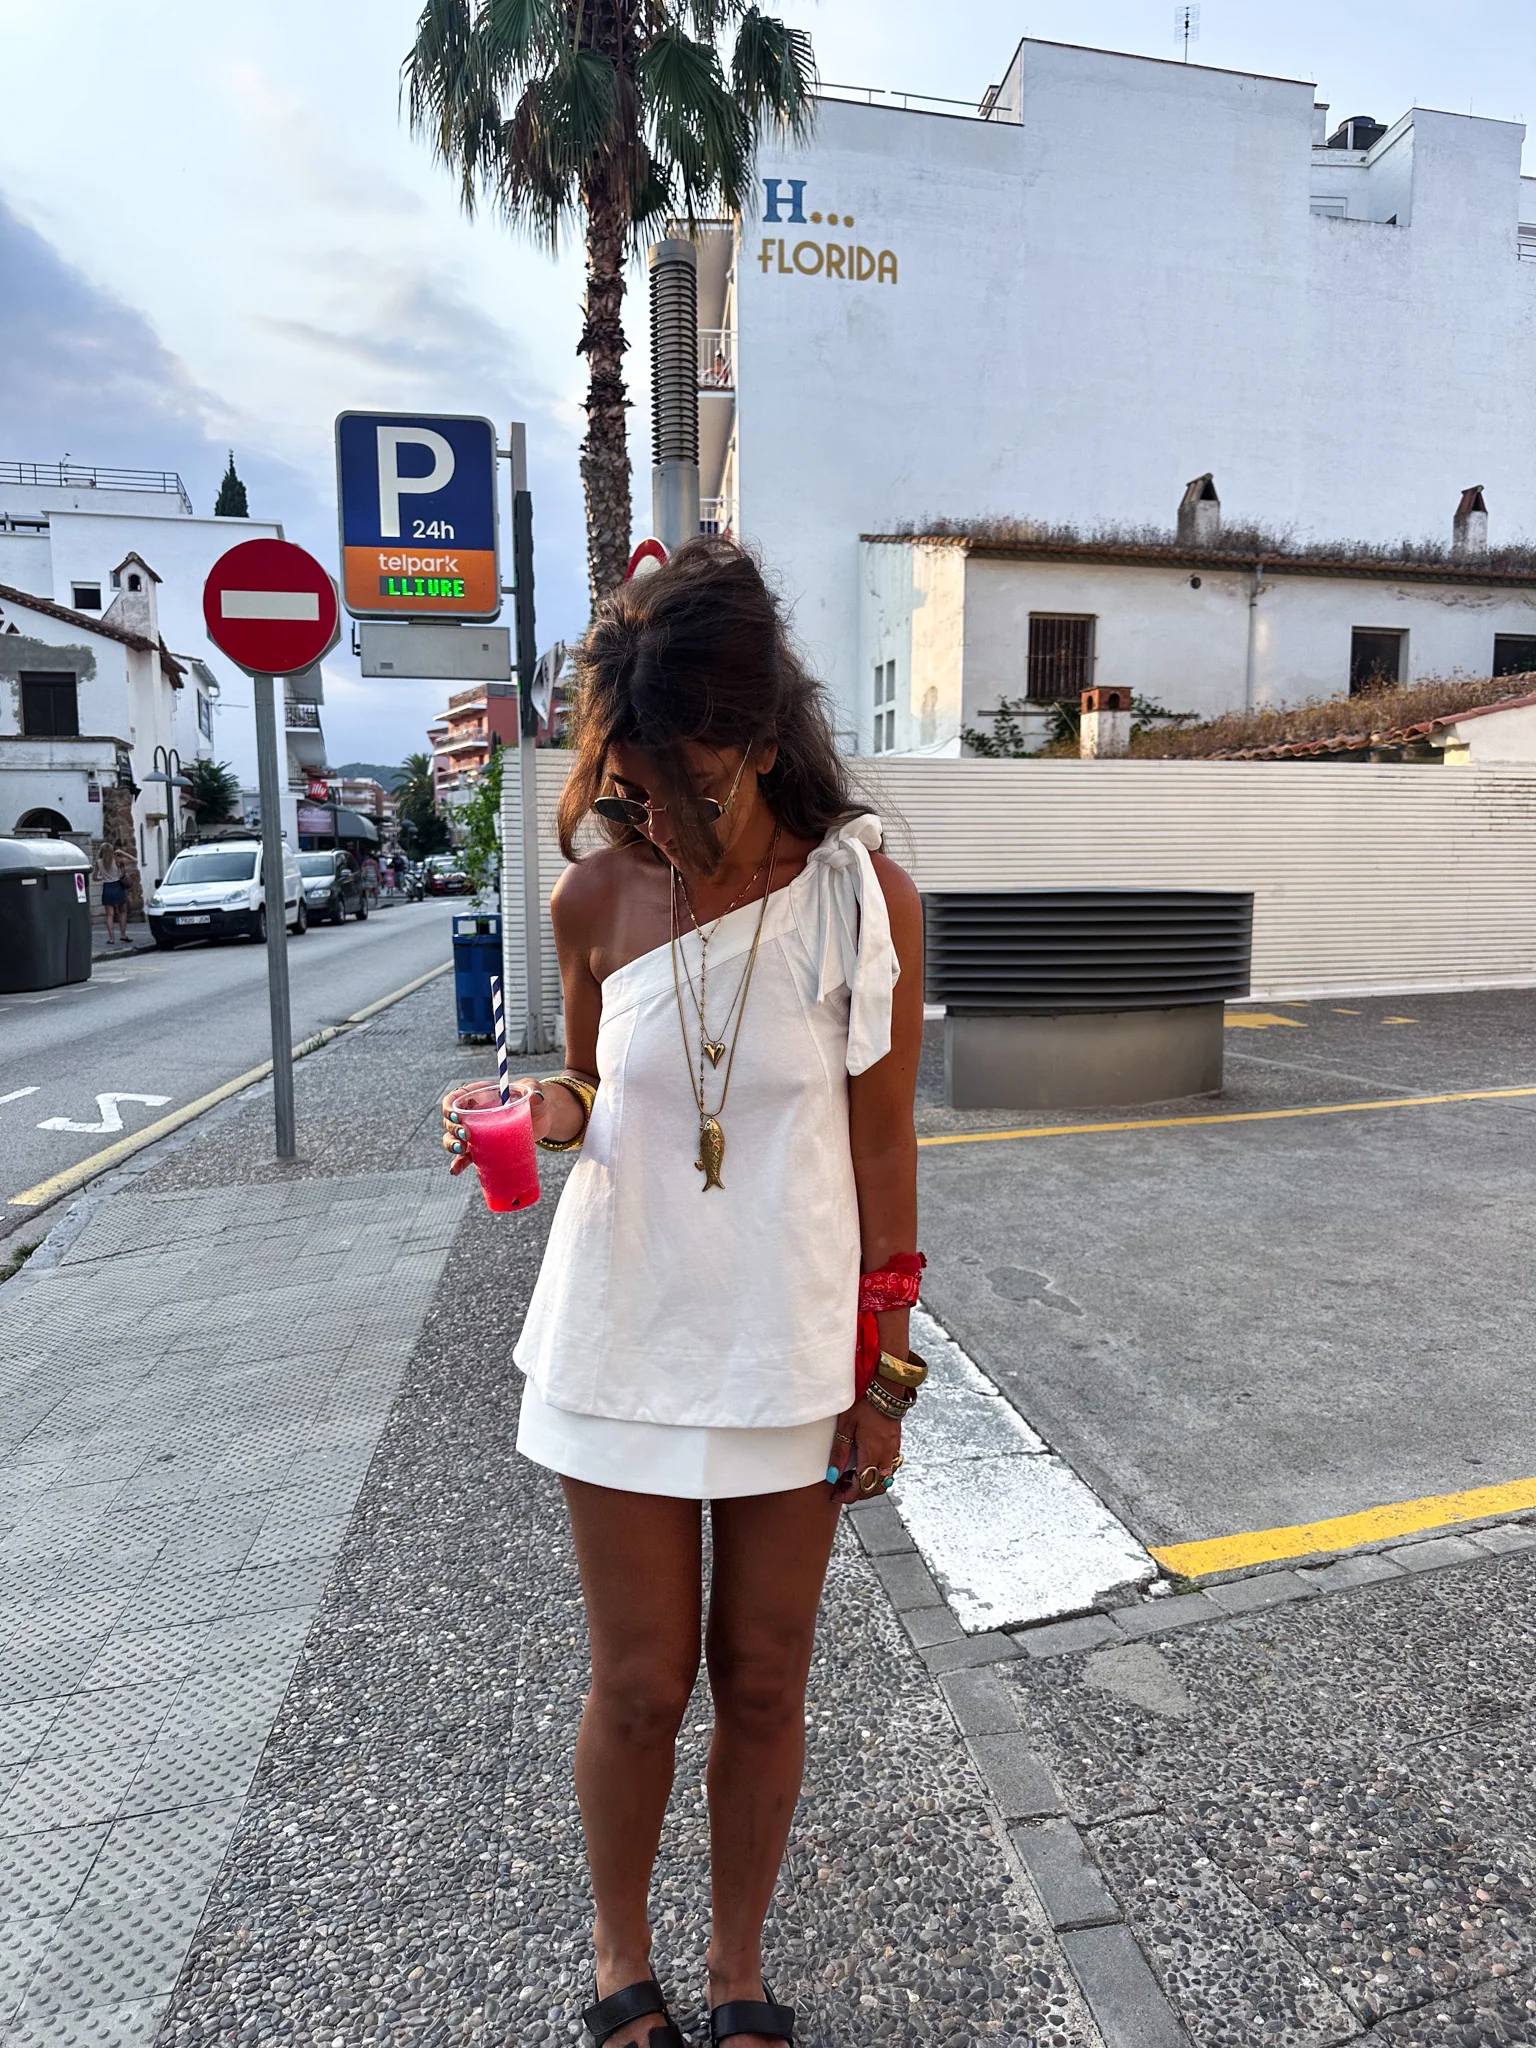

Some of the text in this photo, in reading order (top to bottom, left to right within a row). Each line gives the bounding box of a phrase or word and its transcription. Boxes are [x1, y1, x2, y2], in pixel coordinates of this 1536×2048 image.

[757, 239, 898, 285] FLORIDA
[376, 425, 456, 538] P
[412, 519, 455, 540] 24h
[378, 553, 459, 576] telpark
[311, 783, 327, 797] illy
